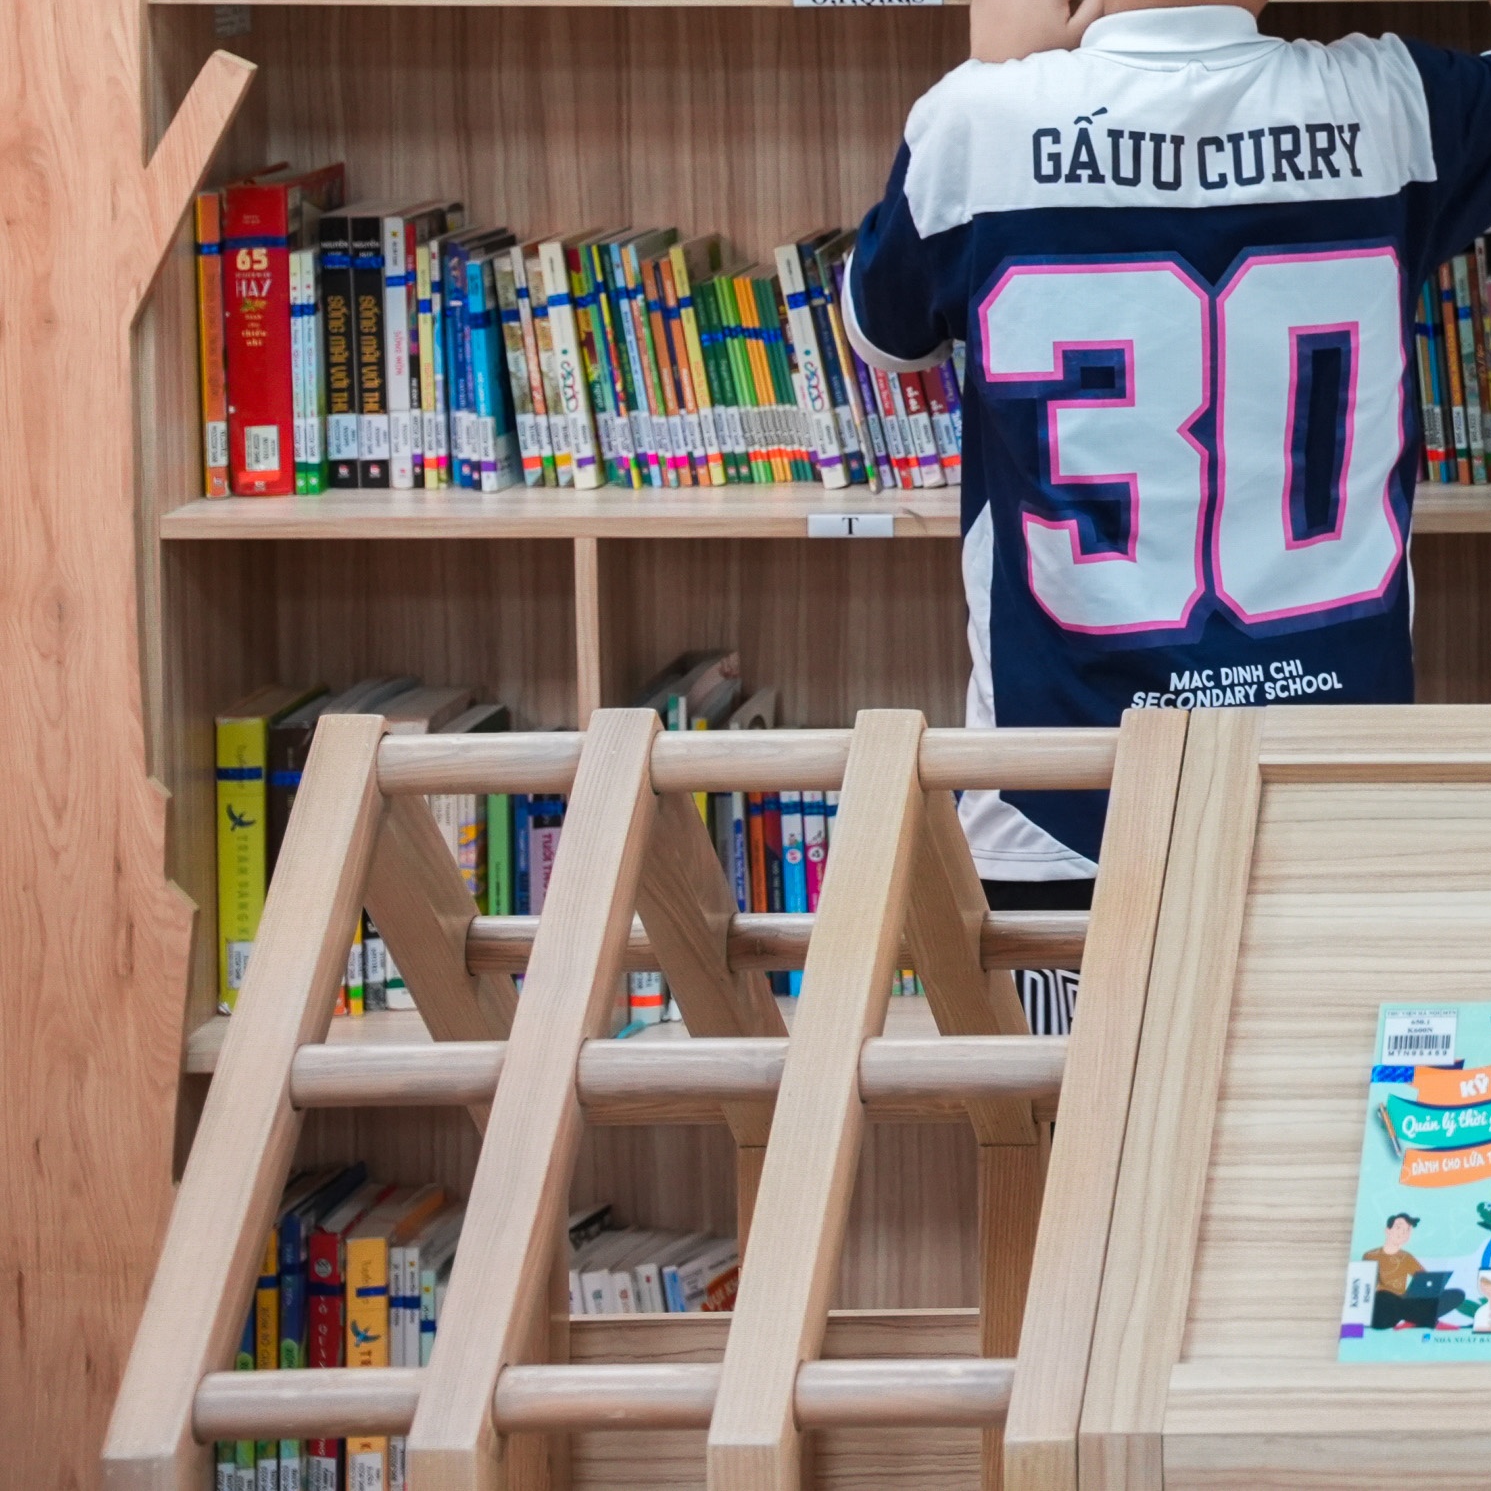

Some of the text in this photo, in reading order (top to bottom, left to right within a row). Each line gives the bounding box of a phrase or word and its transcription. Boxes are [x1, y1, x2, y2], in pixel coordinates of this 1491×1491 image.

[1031, 106, 1362, 191] GẤUU CURRY
[235, 247, 268, 271] 65
[978, 245, 1407, 636] 30
[842, 517, 858, 535] T
[1169, 659, 1304, 692] MAC DINH CHI
[1131, 671, 1343, 709] SECONDARY SCHOOL
[1460, 1075, 1491, 1098] KỸ
[1442, 1155, 1461, 1172] CHO
